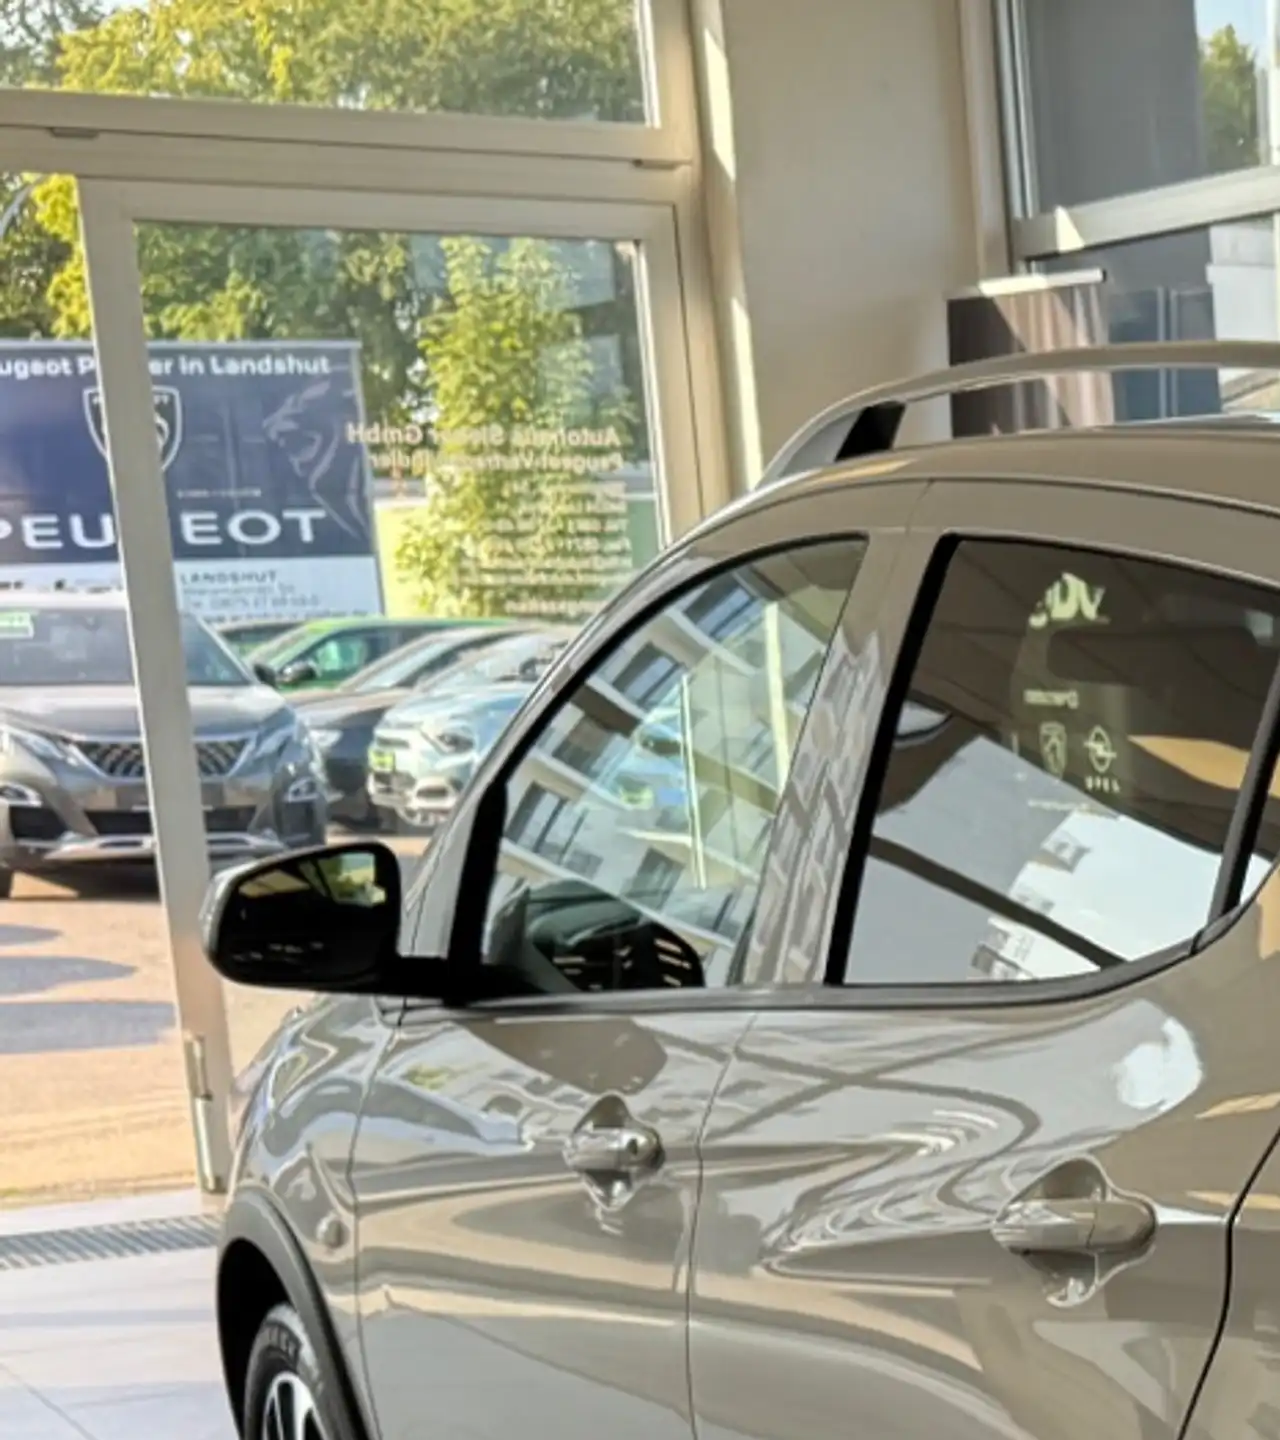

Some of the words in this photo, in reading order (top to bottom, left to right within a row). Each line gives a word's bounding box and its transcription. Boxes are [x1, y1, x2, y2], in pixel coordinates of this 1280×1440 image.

[0, 356, 72, 380] ugeot
[180, 354, 205, 375] in
[210, 352, 331, 376] Landshut
[0, 509, 326, 549] EUEOT
[180, 569, 278, 586] LANDSHUT
